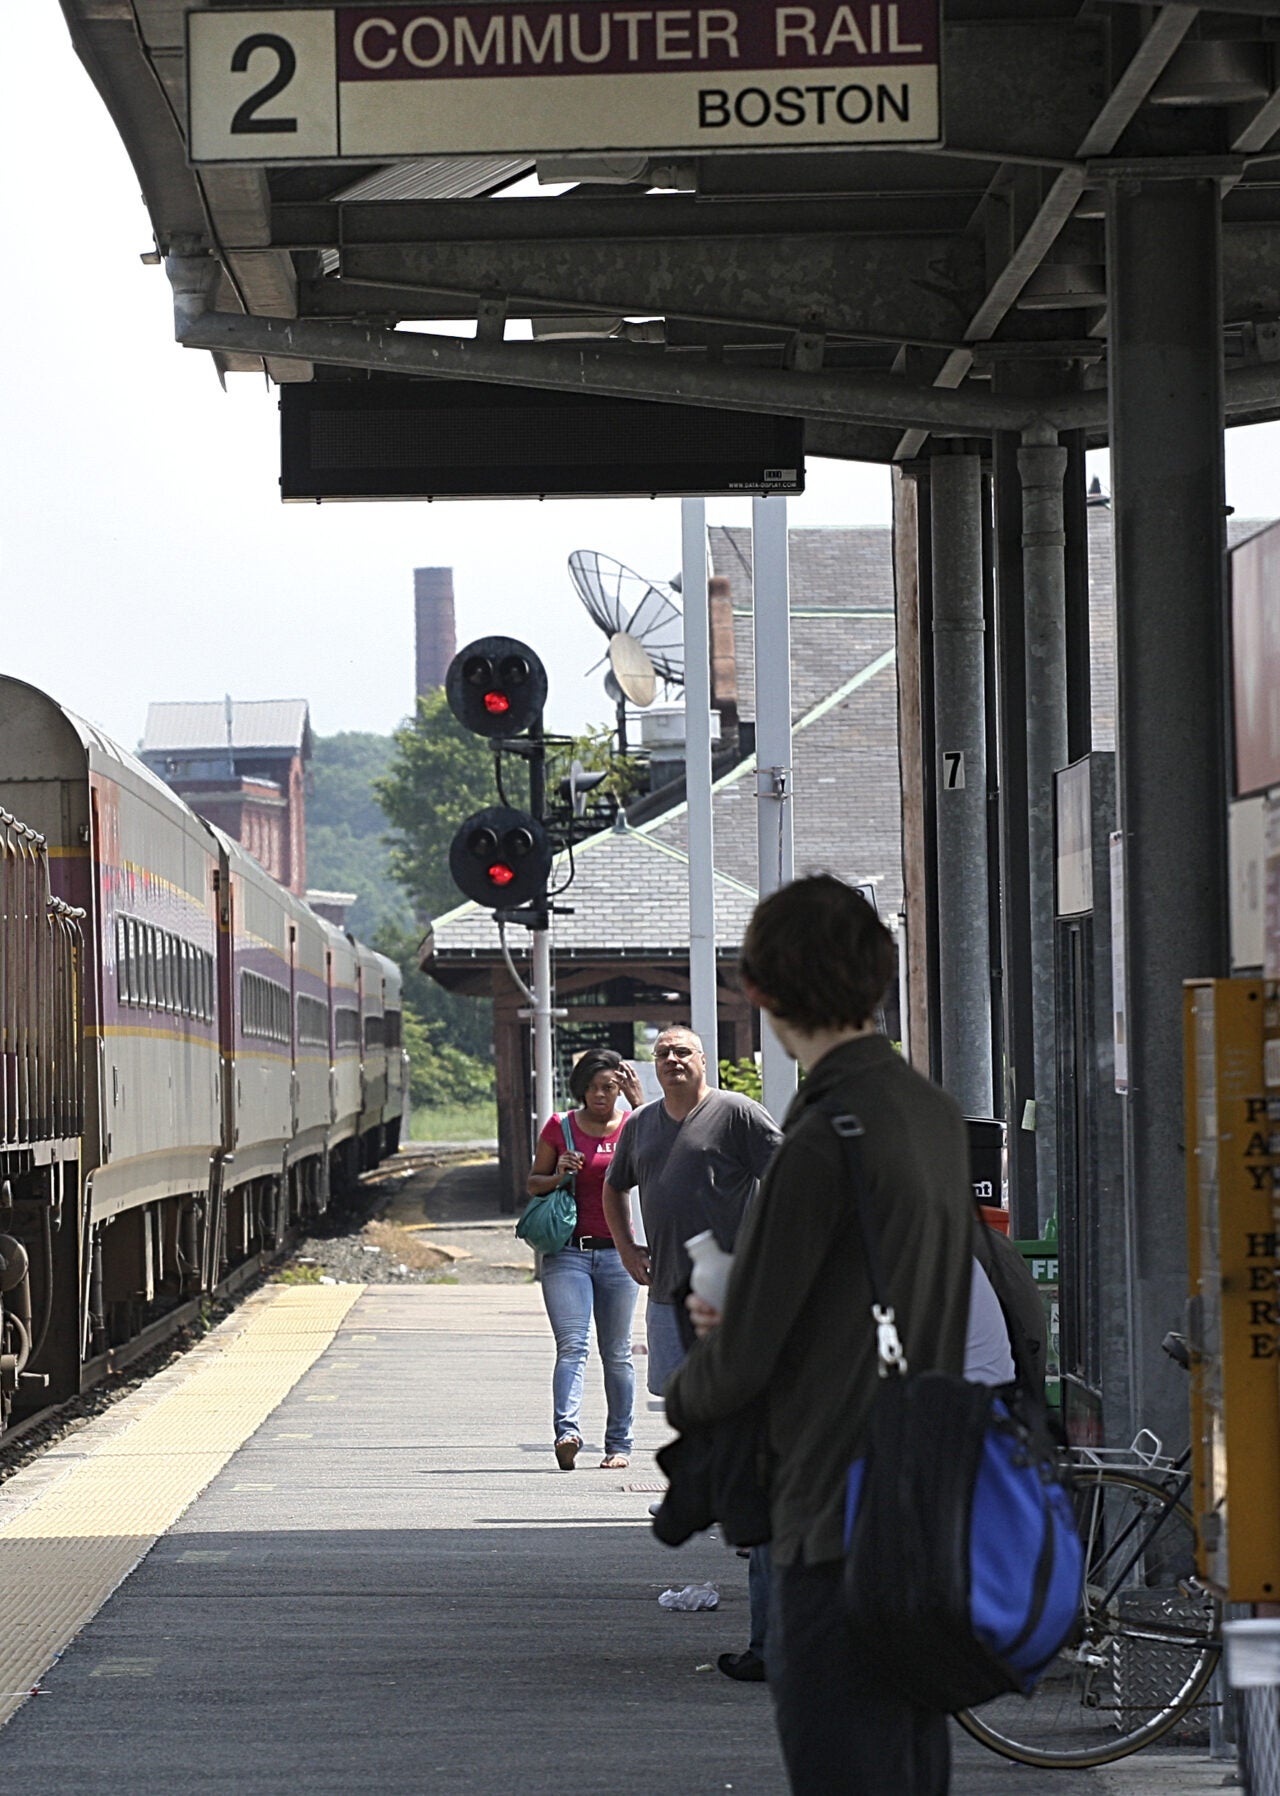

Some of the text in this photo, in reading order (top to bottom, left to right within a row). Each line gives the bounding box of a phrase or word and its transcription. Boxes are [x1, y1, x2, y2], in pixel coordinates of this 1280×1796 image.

[353, 5, 923, 69] COMMUTER RAIL
[229, 33, 298, 135] 2
[697, 83, 910, 128] BOSTON
[945, 752, 961, 788] 7
[1243, 1097, 1277, 1359] PAY HERE
